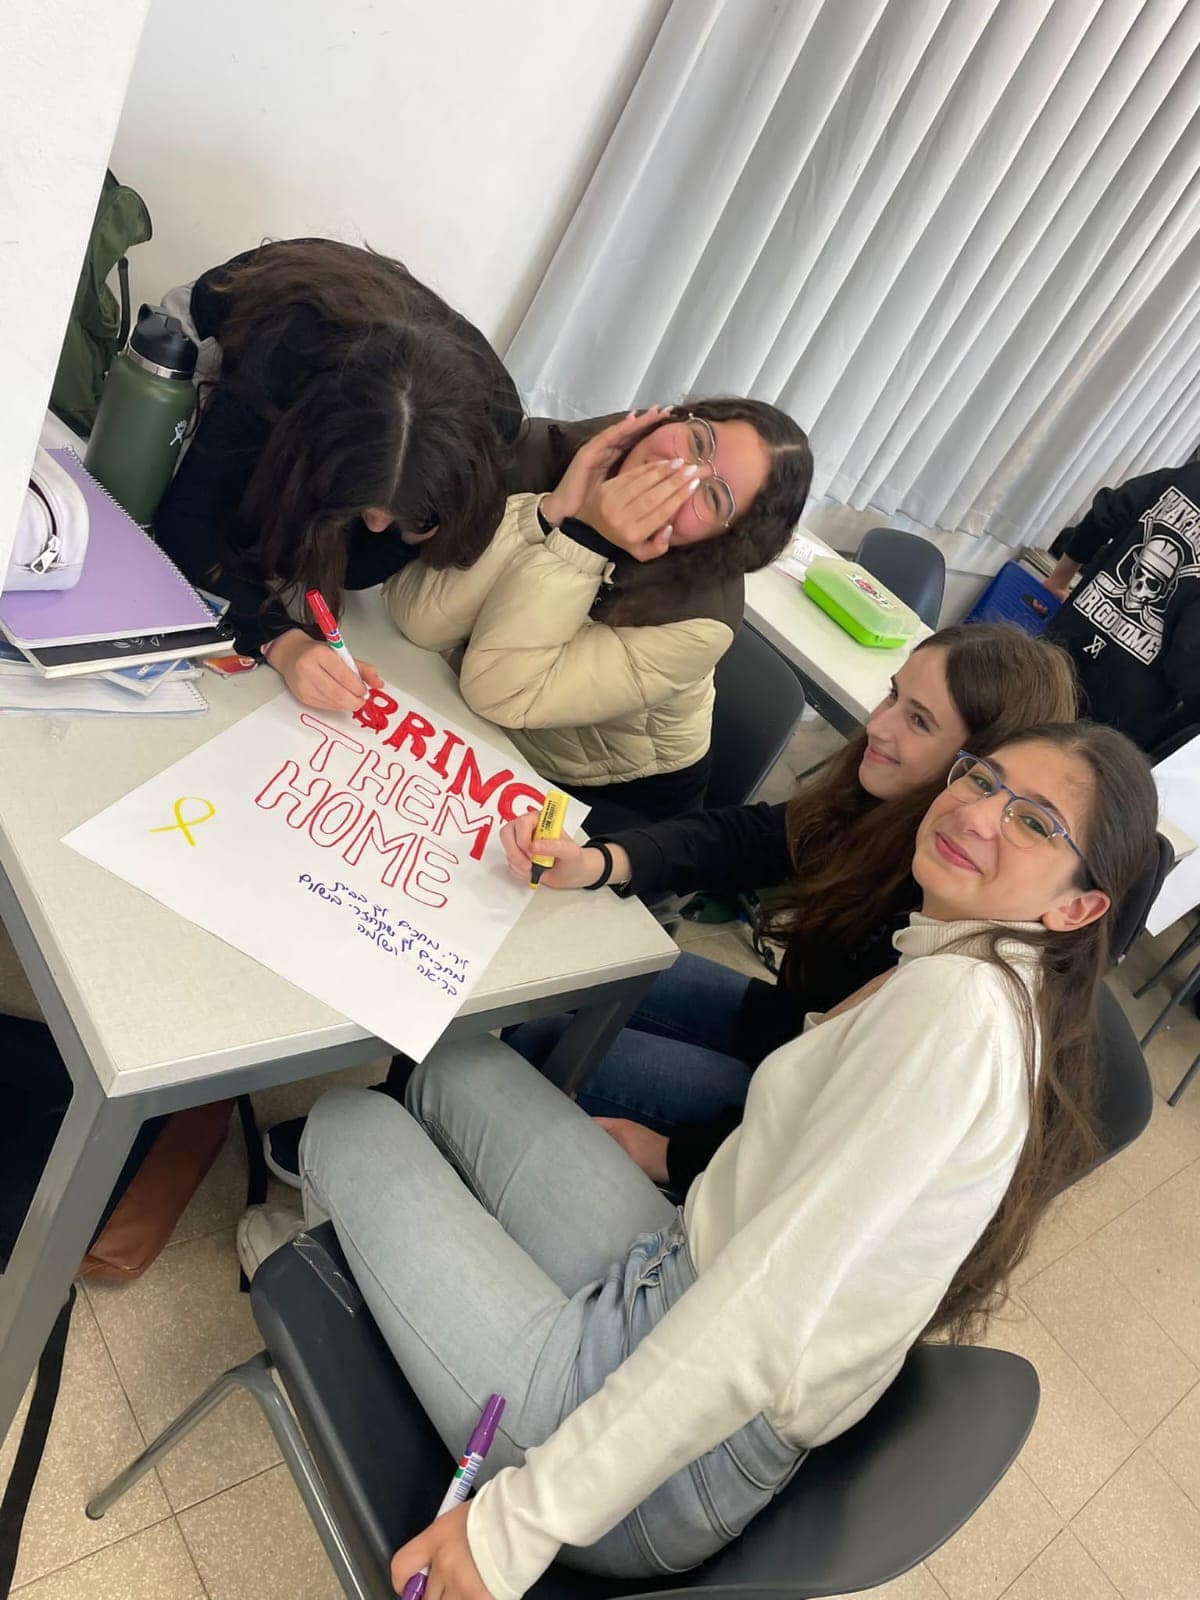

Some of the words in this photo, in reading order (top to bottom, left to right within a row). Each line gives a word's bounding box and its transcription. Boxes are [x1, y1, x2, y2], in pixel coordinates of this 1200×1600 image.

[1093, 600, 1122, 631] GO
[352, 687, 547, 824] BRING
[300, 713, 493, 861] THEM
[255, 760, 459, 908] HOME
[298, 873, 343, 906] בשלום
[327, 881, 368, 903] בבית
[372, 903, 389, 918] לך
[356, 923, 399, 956] ושלמה
[397, 919, 441, 951] מחכים
[416, 963, 458, 996] בריאה
[418, 949, 465, 984] מחכים
